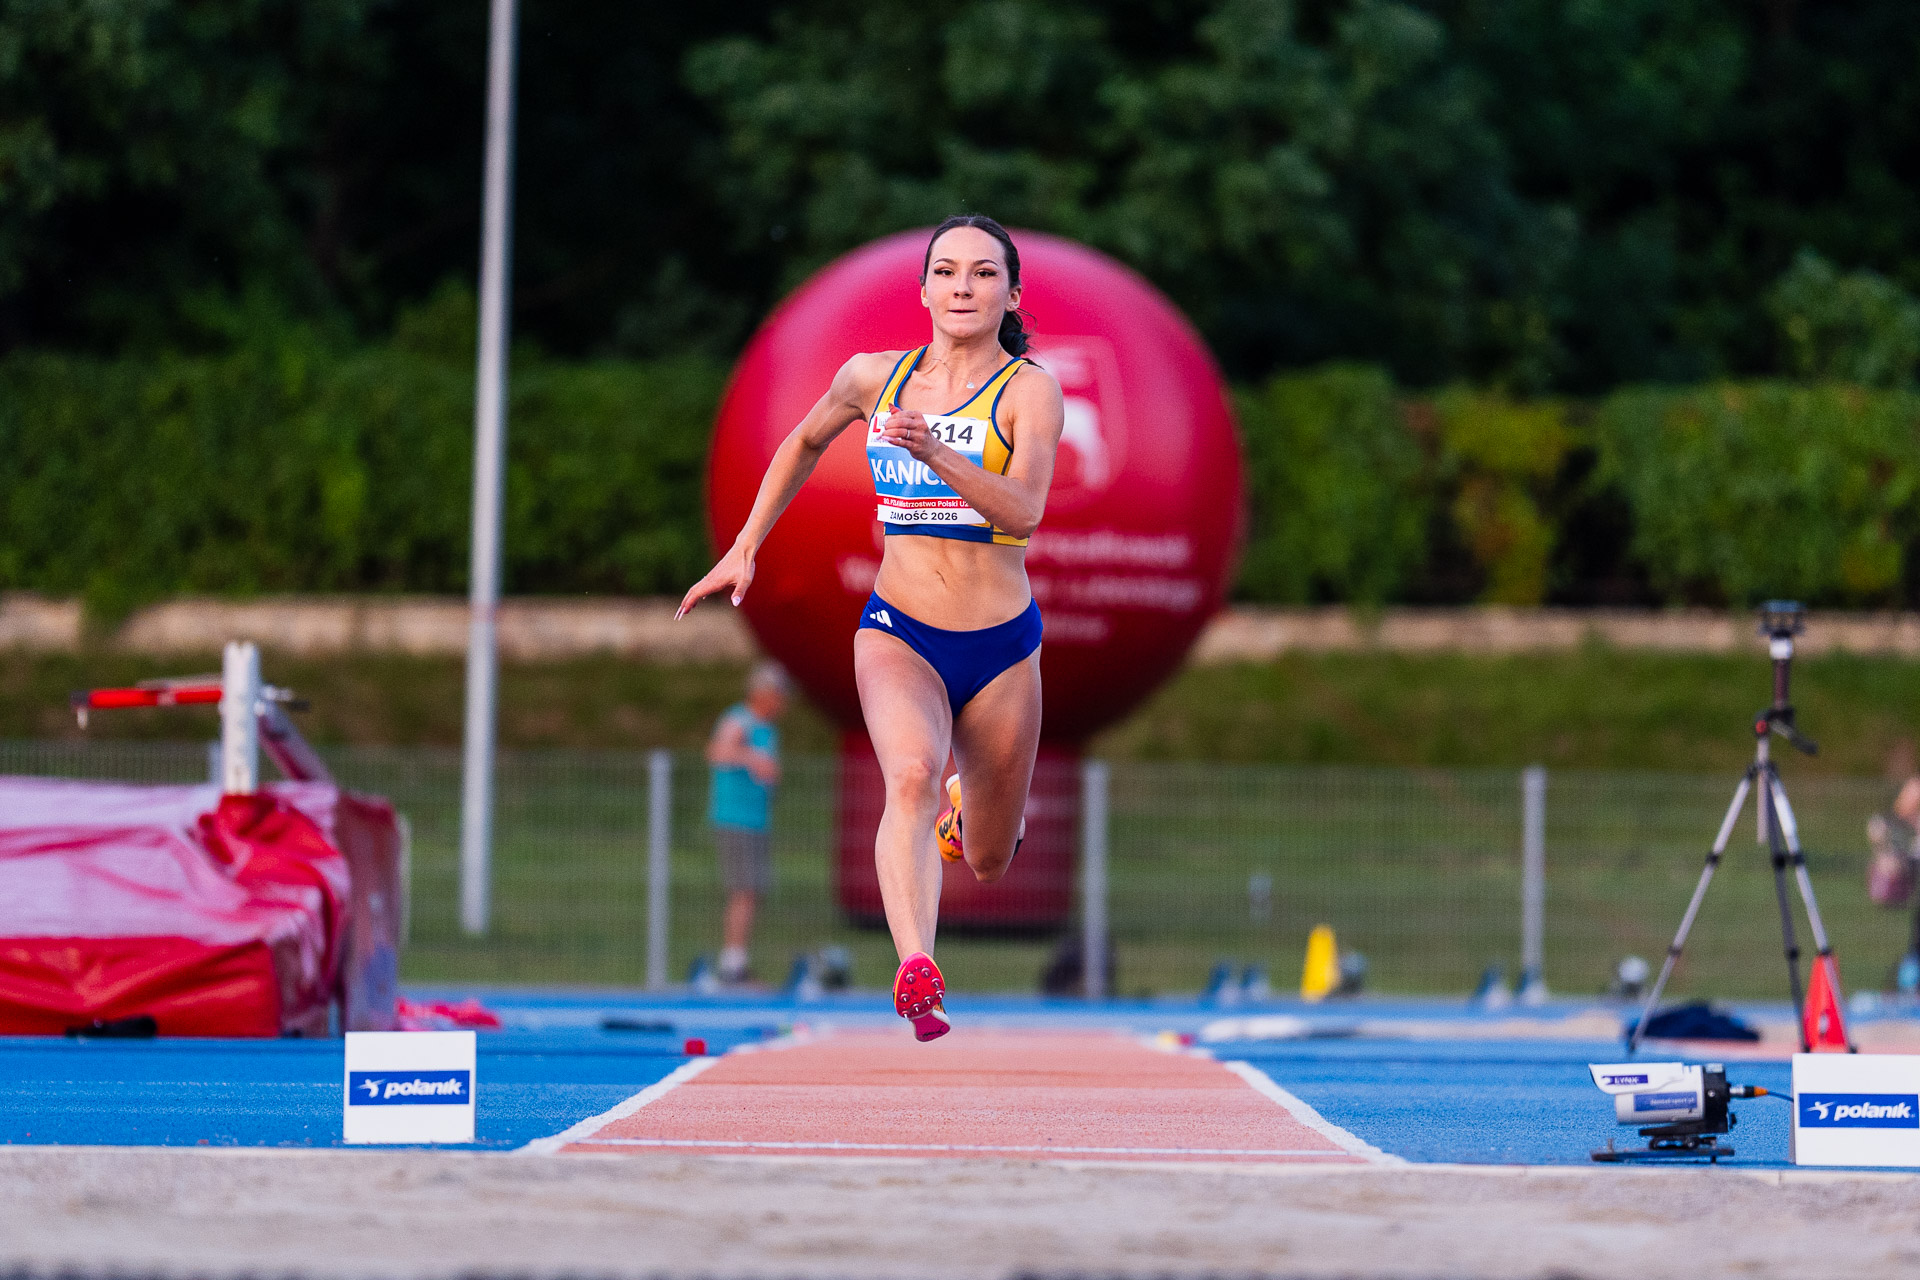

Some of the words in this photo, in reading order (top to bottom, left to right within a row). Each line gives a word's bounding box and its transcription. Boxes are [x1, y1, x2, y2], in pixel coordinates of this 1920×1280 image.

[930, 422, 973, 444] 614
[871, 459, 947, 485] KANIC
[937, 500, 958, 508] Polski
[890, 509, 929, 521] ZAMOŚĆ
[931, 512, 958, 521] 2026
[383, 1078, 463, 1099] polanik
[1834, 1102, 1911, 1121] polanik
